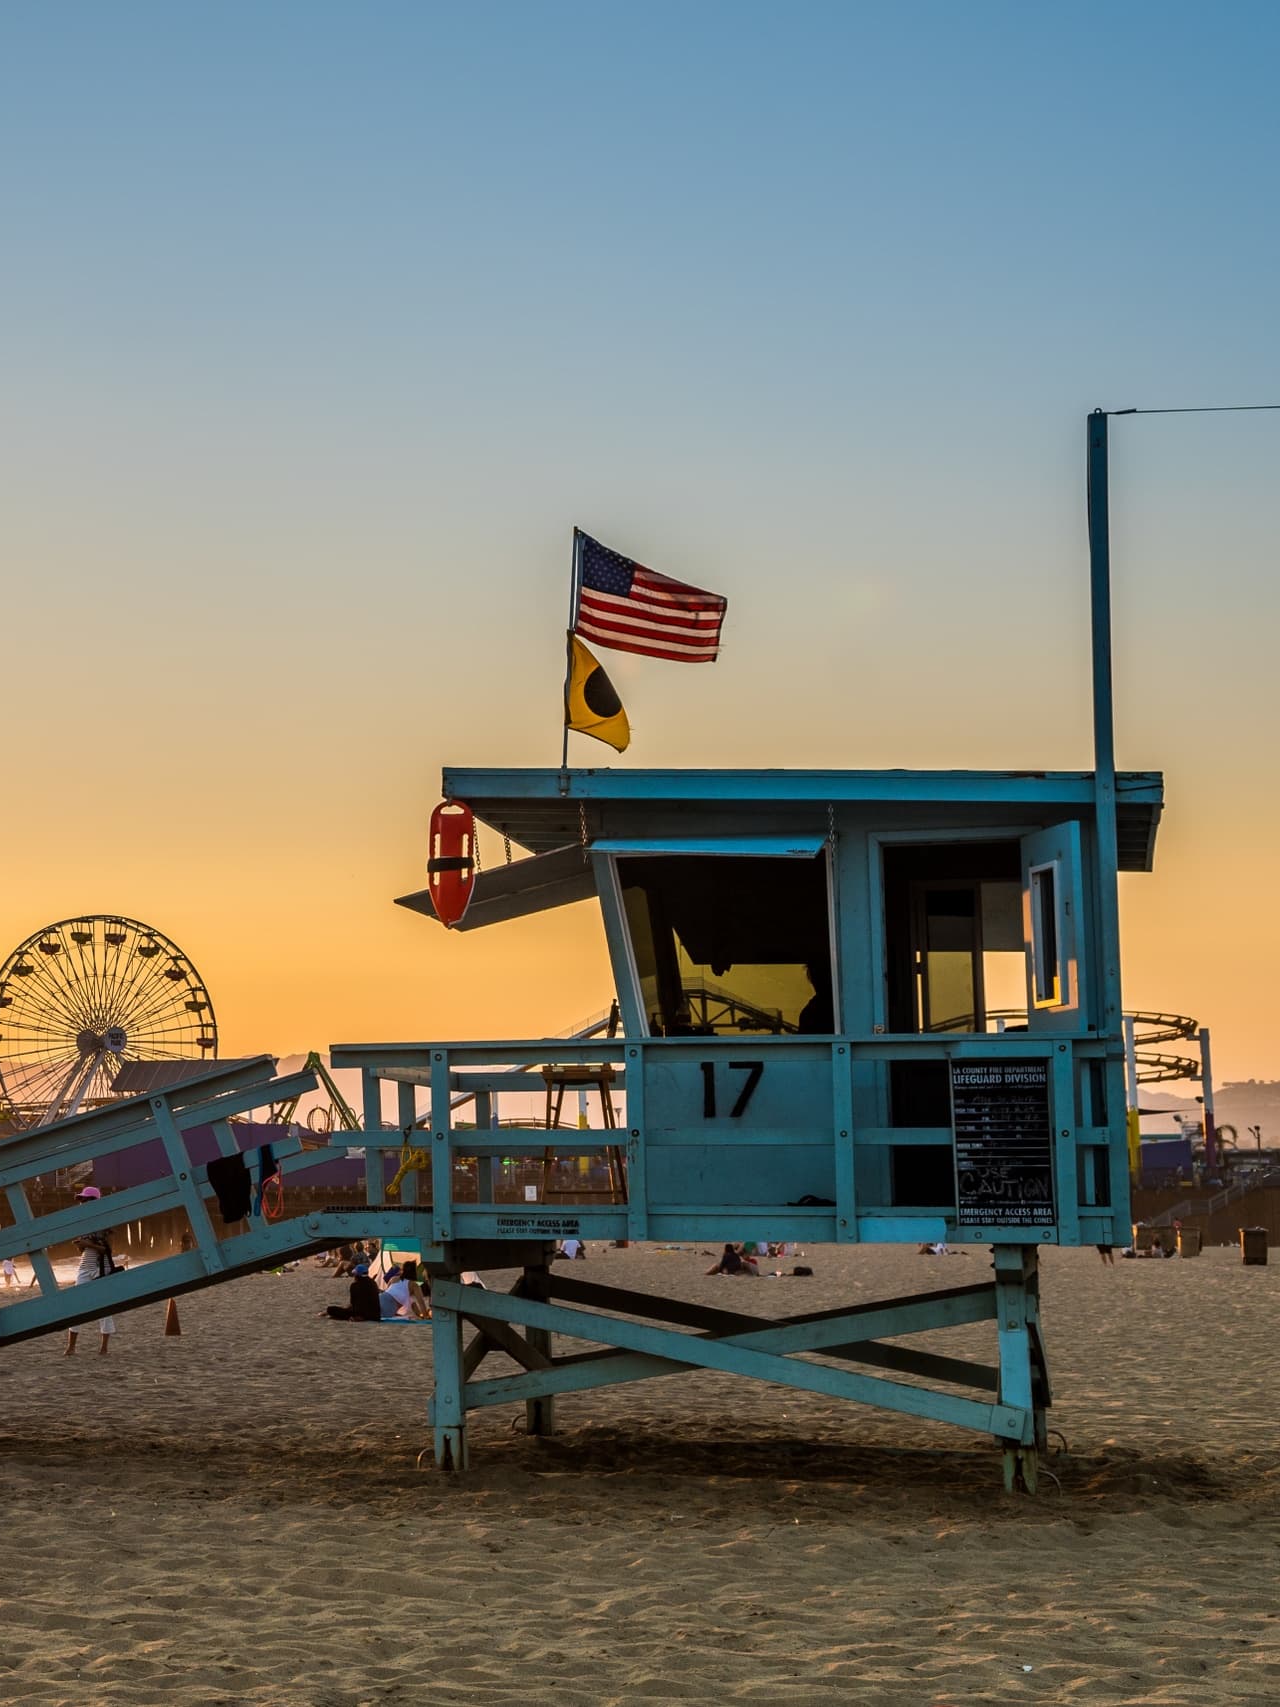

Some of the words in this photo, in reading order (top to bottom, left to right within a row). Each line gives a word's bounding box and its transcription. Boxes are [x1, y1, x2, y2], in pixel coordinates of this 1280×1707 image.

[953, 1066, 961, 1074] LA
[962, 1066, 987, 1074] COUNTY
[1004, 1065, 1046, 1073] DEPARTMENT
[953, 1074, 1002, 1084] LIFEGUARD
[1004, 1073, 1047, 1083] DIVISION
[700, 1061, 764, 1118] 17
[960, 1208, 1002, 1216] EMERGENCY
[1004, 1208, 1031, 1216] ACCESS
[1033, 1208, 1053, 1216] AREA
[497, 1218, 535, 1226] EMERGENCY
[537, 1219, 561, 1227] ACCESS
[562, 1219, 580, 1227] AREA
